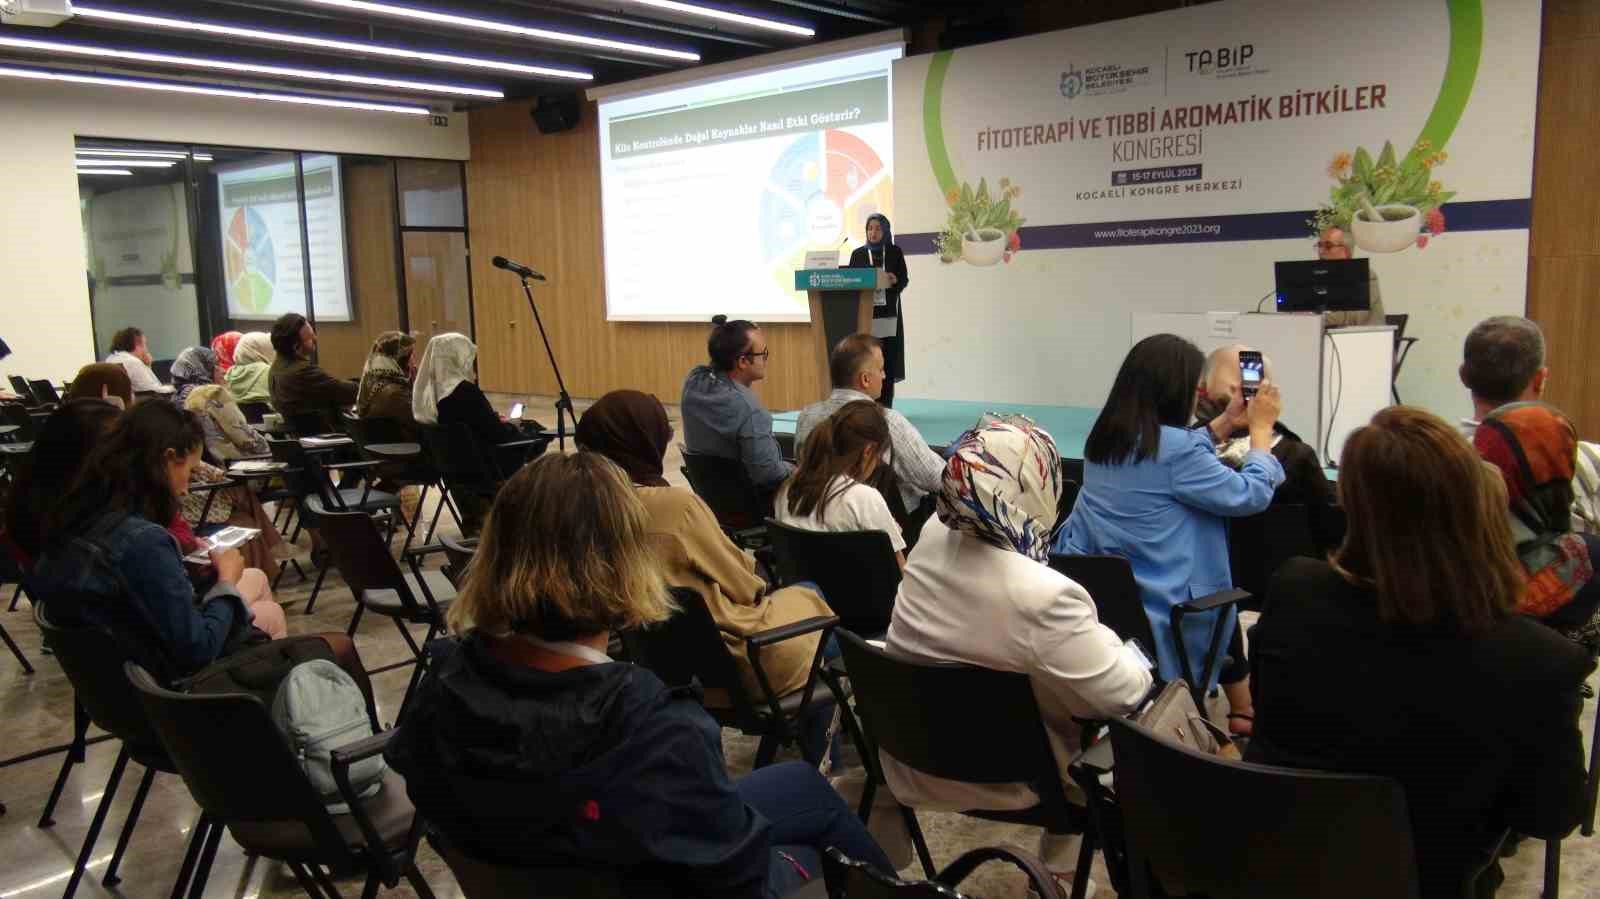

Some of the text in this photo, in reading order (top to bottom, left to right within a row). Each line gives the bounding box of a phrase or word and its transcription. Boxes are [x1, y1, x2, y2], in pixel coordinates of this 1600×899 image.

[977, 83, 1387, 151] FİTOTERAPİ VE TIBBİ AROMATİK BİTKİLER
[1112, 129, 1203, 163] KONGRESİ
[1132, 172, 1151, 181] 15-17
[1177, 167, 1198, 177] 2023
[1076, 179, 1243, 201] KOCAELİ KONGRE MERKEZİ
